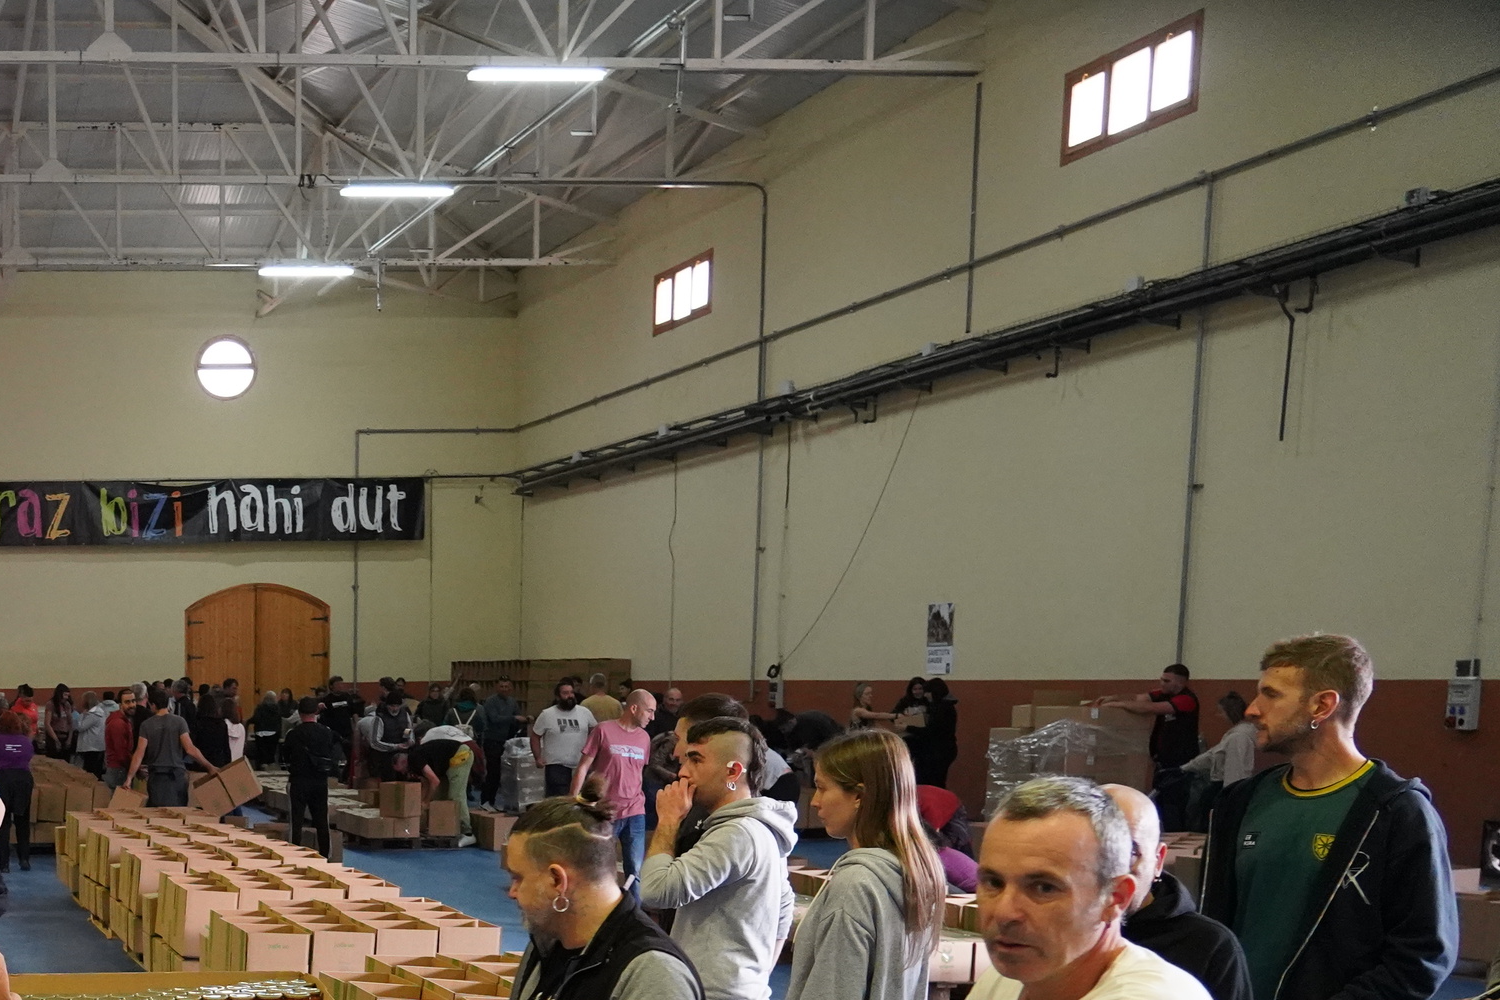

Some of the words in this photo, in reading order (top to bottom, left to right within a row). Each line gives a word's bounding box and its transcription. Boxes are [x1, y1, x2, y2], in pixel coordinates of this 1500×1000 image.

[100, 486, 183, 541] bizi
[207, 483, 305, 536] nahi
[331, 482, 407, 534] dut
